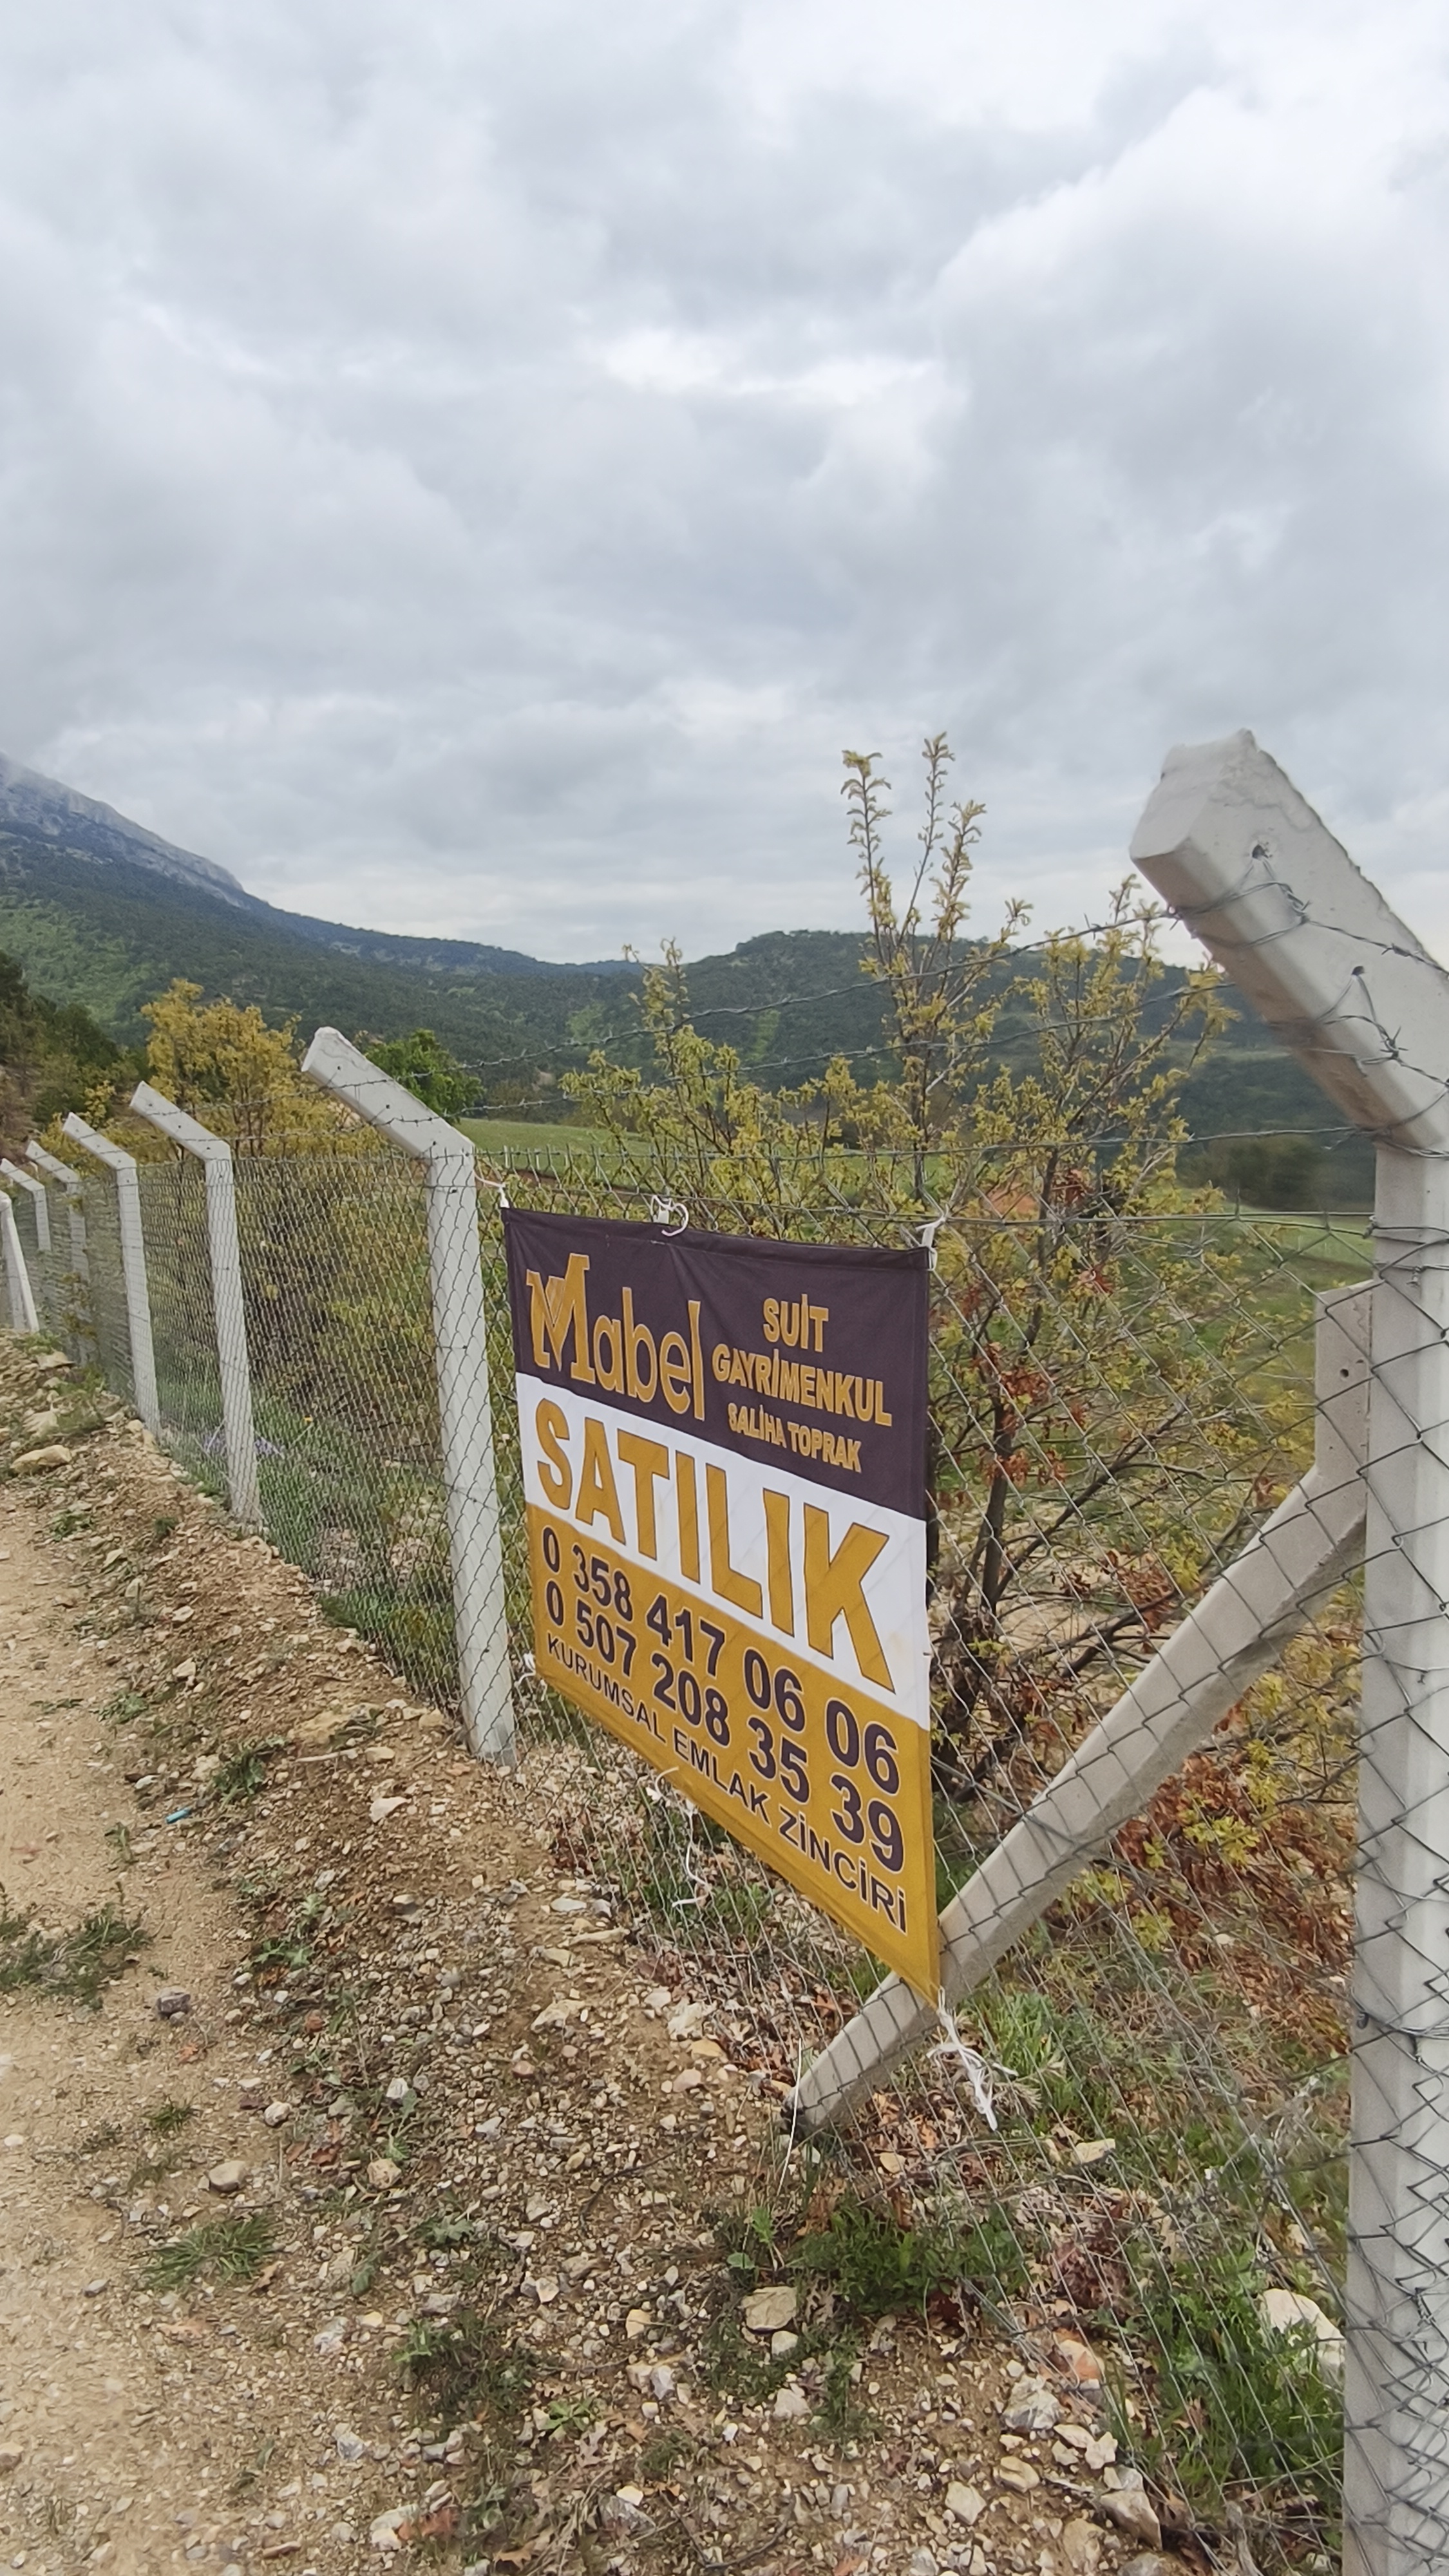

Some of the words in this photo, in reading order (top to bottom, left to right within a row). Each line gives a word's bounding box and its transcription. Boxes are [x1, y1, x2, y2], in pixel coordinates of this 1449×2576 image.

[526, 1253, 705, 1421] Mabel
[712, 1343, 893, 1426] GAYRİMENKUL
[763, 1294, 829, 1352] SUİT
[536, 1398, 896, 1694] SATILIK
[728, 1403, 786, 1448] SALİHA
[788, 1422, 862, 1472] TOPRAK
[543, 1527, 560, 1573] 0
[573, 1544, 632, 1622] 358
[646, 1595, 726, 1676] 417
[744, 1647, 805, 1732] 06
[826, 1698, 900, 1795] 06
[546, 1580, 564, 1626] 0
[576, 1599, 637, 1676] 507
[651, 1653, 731, 1746] 208
[748, 1717, 810, 1803] 35
[831, 1775, 904, 1872] 39
[547, 1633, 667, 1743] KURUMSAL
[674, 1728, 771, 1826] EMLAK
[779, 1806, 907, 1933] ZİNCİRİ
